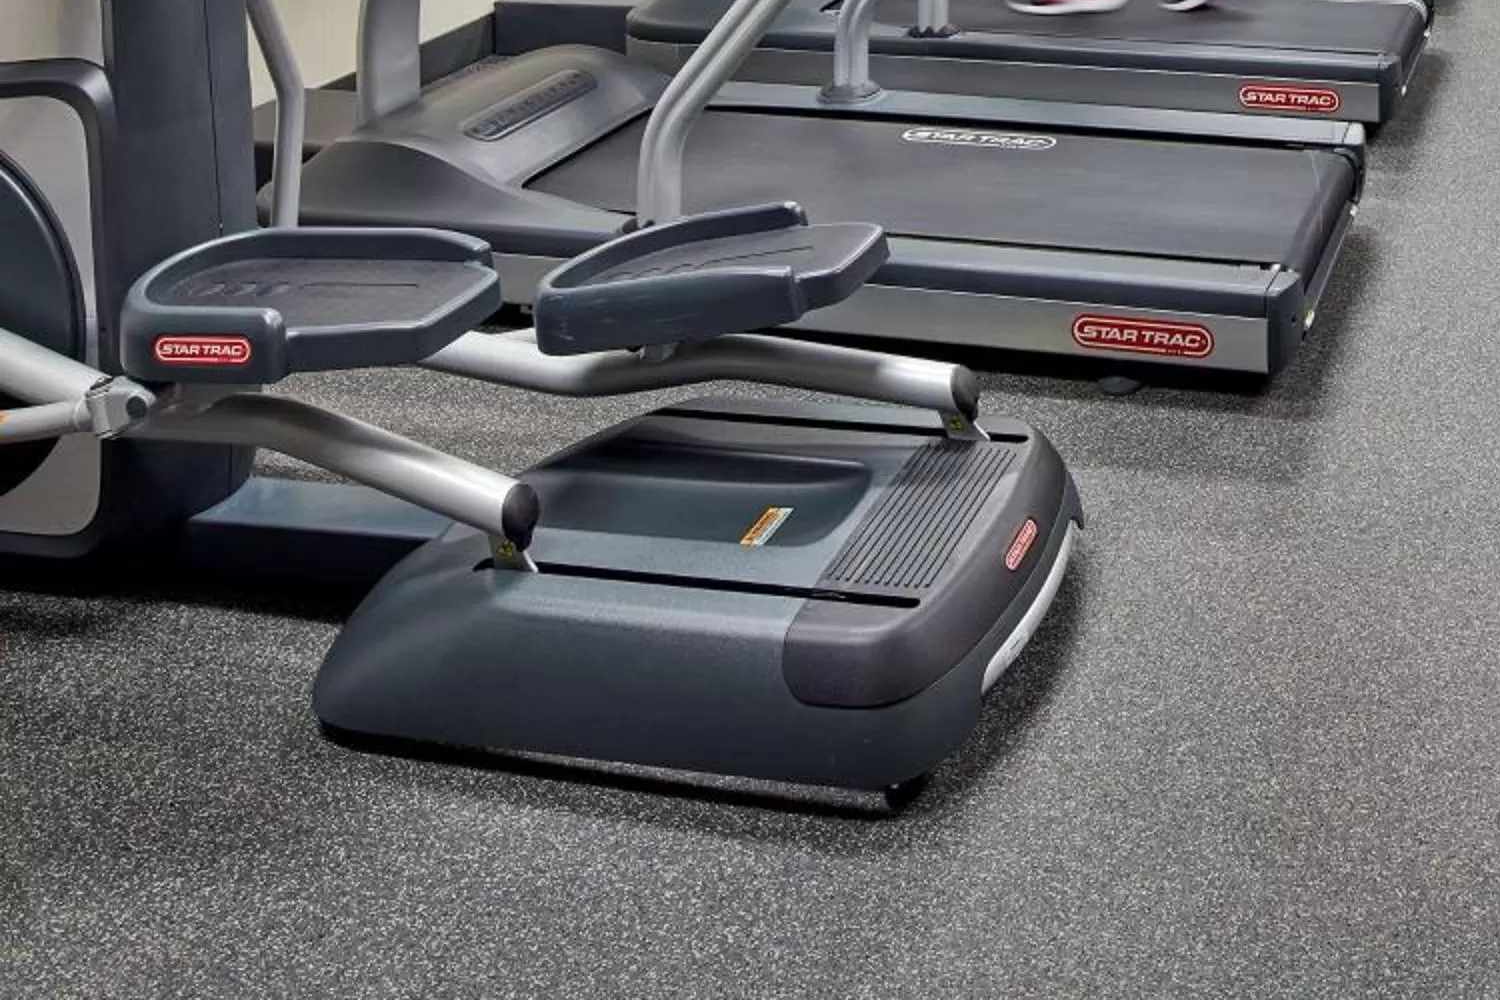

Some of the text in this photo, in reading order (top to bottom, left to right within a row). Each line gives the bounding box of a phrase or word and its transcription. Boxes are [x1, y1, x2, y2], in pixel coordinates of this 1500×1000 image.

[1244, 91, 1331, 105] STAR TRAC
[1079, 325, 1201, 348] STAR TRAC
[160, 343, 243, 357] STAR TRAC
